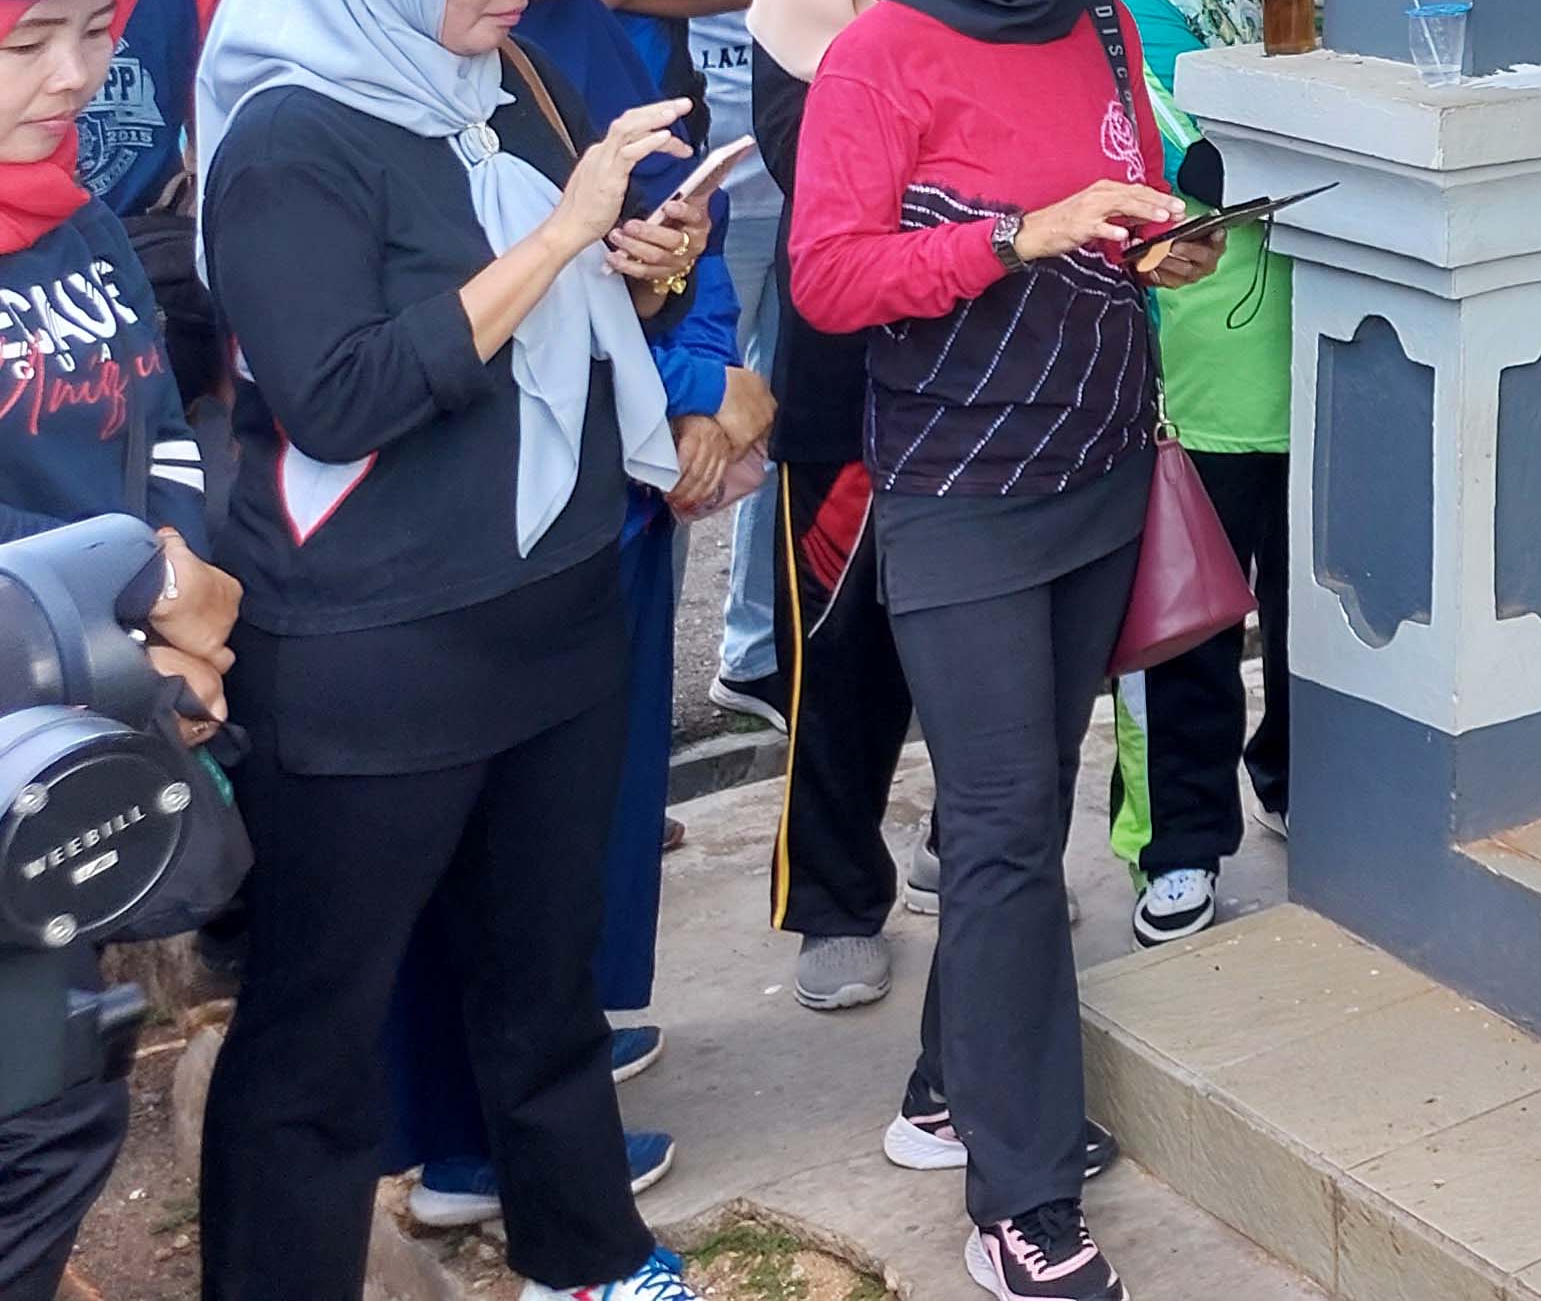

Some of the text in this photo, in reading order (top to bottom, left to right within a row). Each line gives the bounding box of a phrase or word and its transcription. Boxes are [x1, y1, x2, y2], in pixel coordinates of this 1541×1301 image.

[104, 66, 137, 101] PP
[107, 131, 153, 143] 2015
[22, 804, 147, 880] WEEBILL
